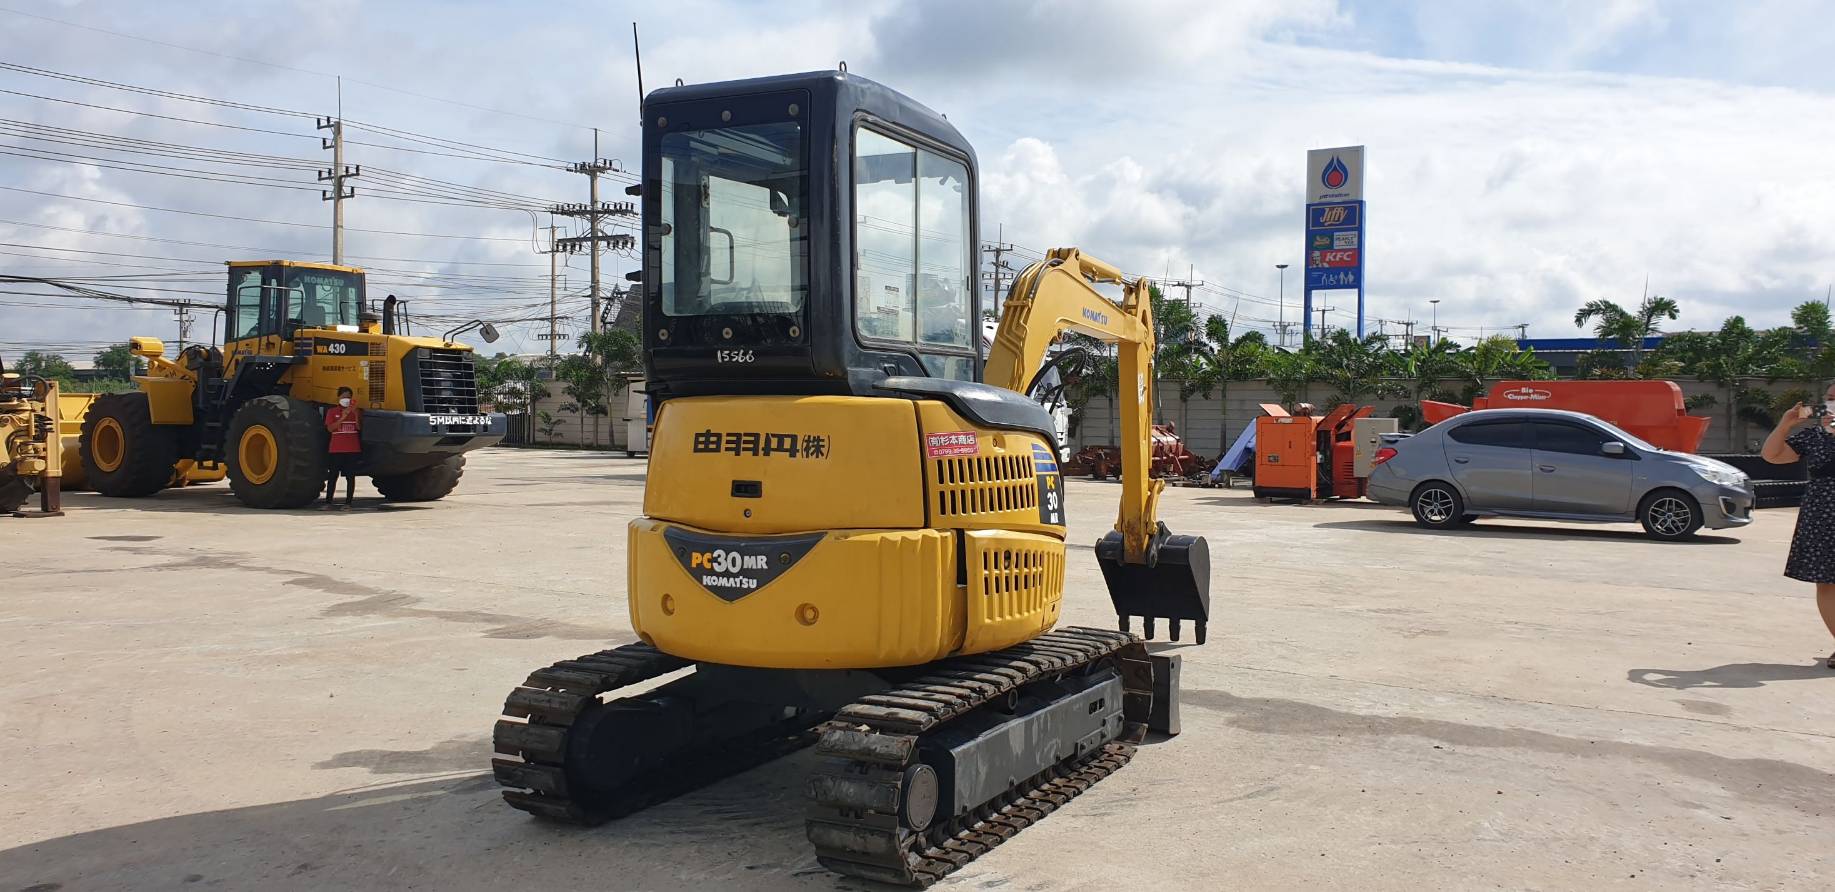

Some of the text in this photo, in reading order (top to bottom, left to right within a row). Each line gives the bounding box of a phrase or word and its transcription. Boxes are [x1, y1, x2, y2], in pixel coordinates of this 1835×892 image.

[1320, 206, 1348, 226] Jiffy
[1325, 251, 1353, 262] KFC
[304, 275, 344, 287] KOMATSU
[1082, 306, 1108, 326] KOMATSU
[717, 349, 755, 363] 15566
[1045, 475, 1056, 490] PC
[1047, 491, 1058, 511] 30
[702, 575, 757, 589] KOMATSU
